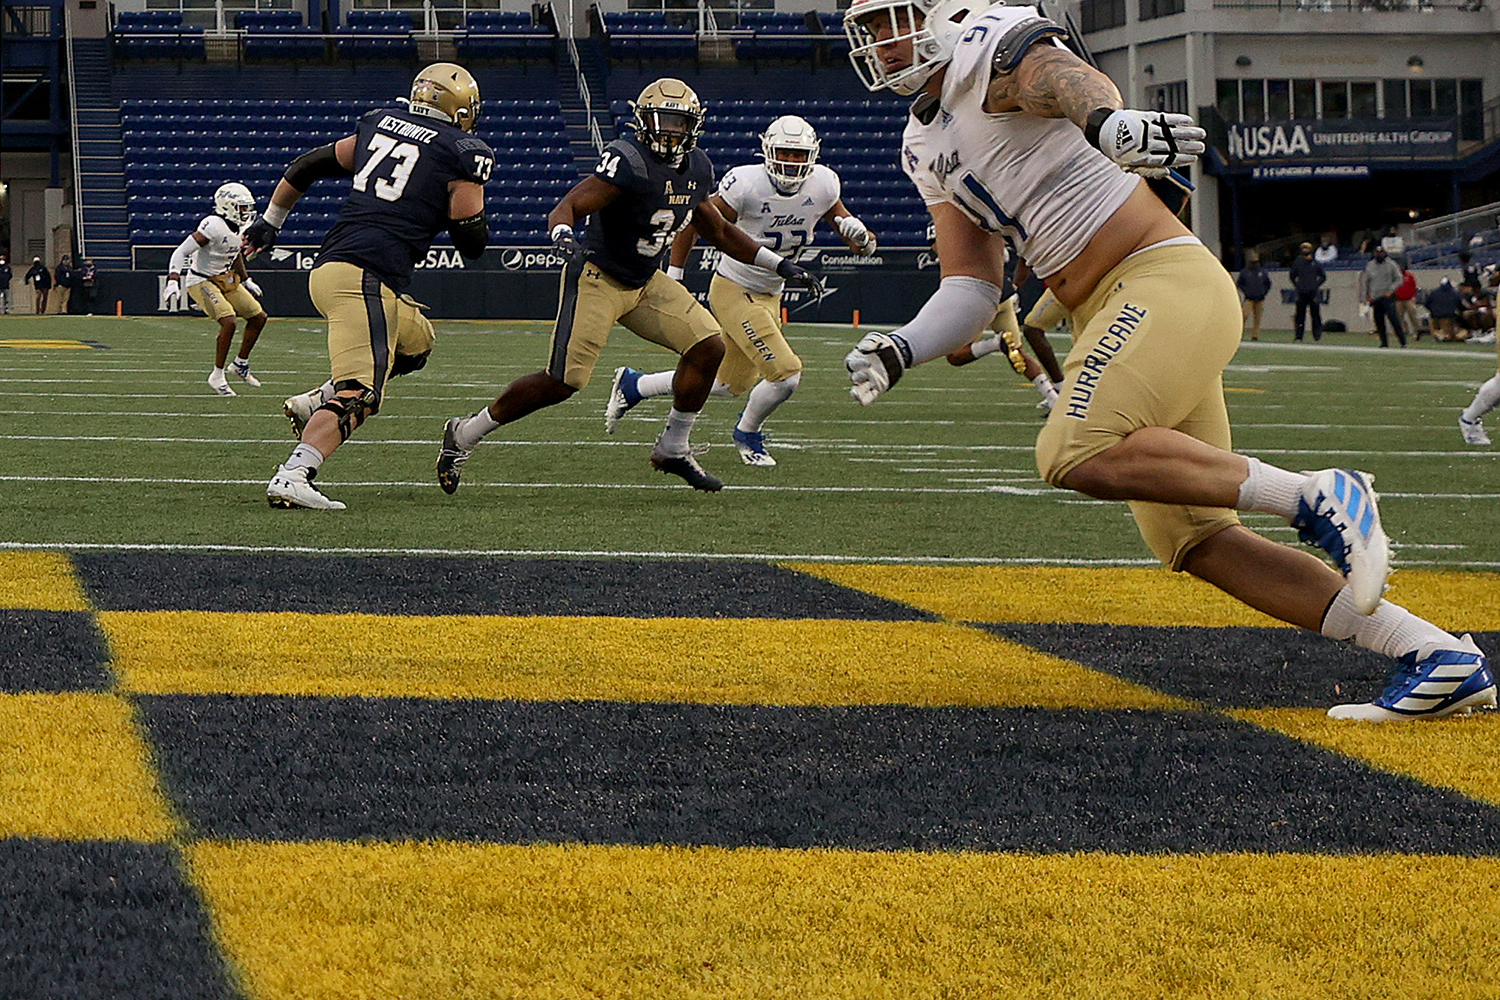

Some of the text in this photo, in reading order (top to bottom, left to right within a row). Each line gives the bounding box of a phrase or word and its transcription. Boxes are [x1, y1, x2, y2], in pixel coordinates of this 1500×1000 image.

[1243, 124, 1311, 156] USAA
[352, 132, 421, 202] 73
[472, 154, 493, 181] 73
[595, 151, 622, 178] 34
[668, 195, 692, 205] NAVY
[770, 214, 805, 228] Tulsa
[821, 254, 883, 266] Constellation
[741, 320, 776, 361] GOLDEN
[1065, 303, 1147, 419] HURRICANE
